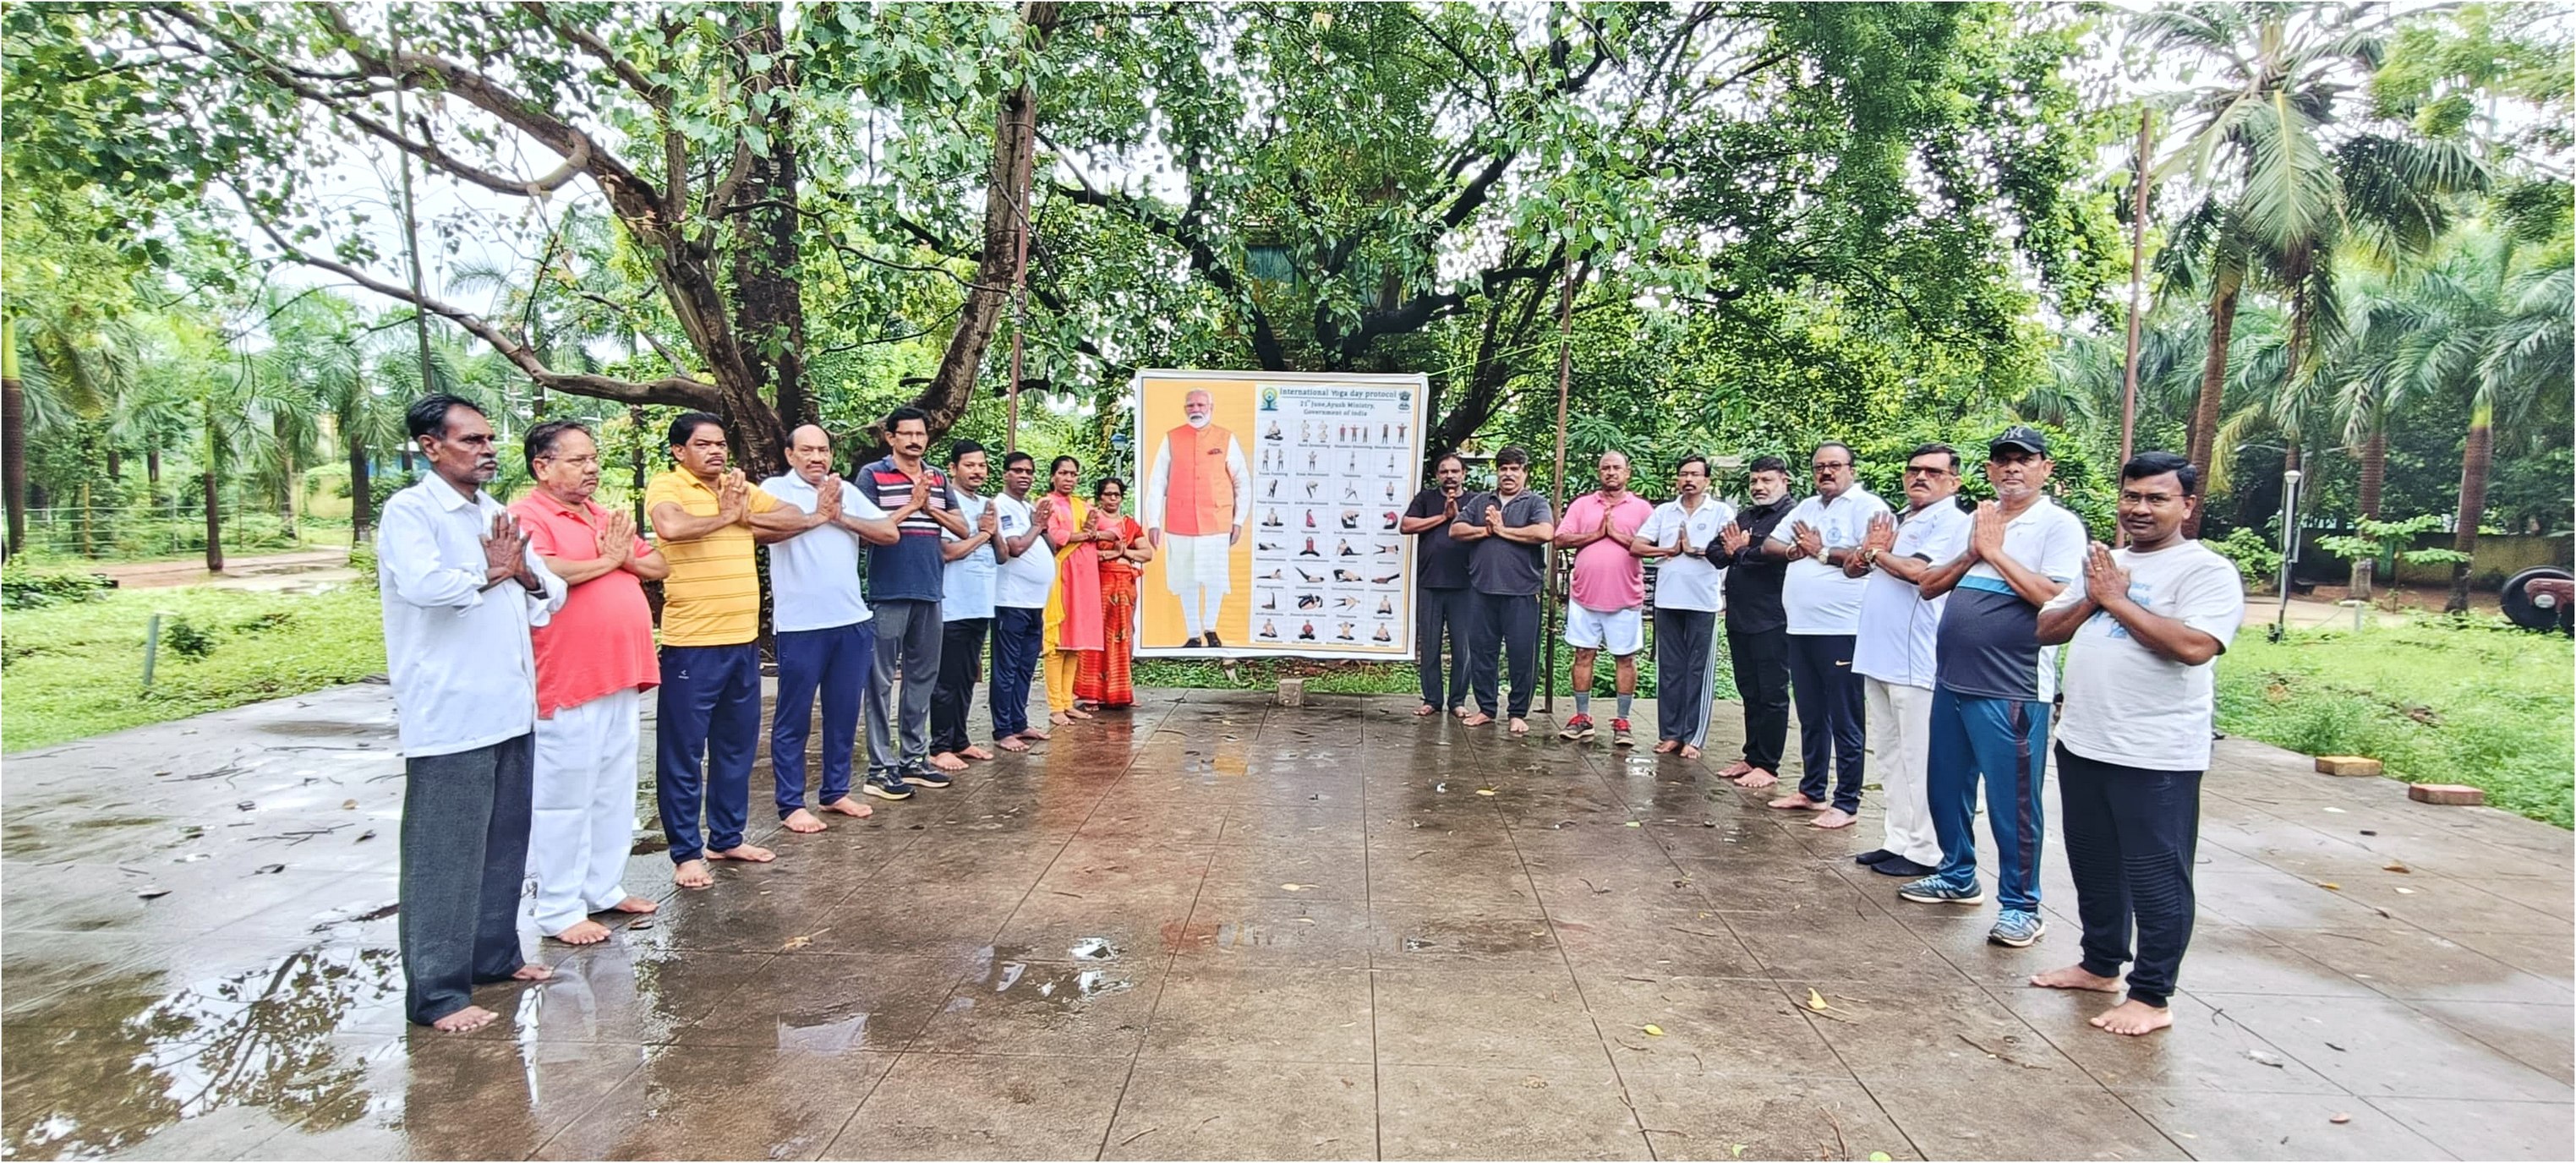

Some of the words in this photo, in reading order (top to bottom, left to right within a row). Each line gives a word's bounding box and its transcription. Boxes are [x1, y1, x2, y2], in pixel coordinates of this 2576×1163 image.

[1280, 388, 1329, 396] International
[1350, 390, 1363, 398] day
[1365, 390, 1397, 399] protocol
